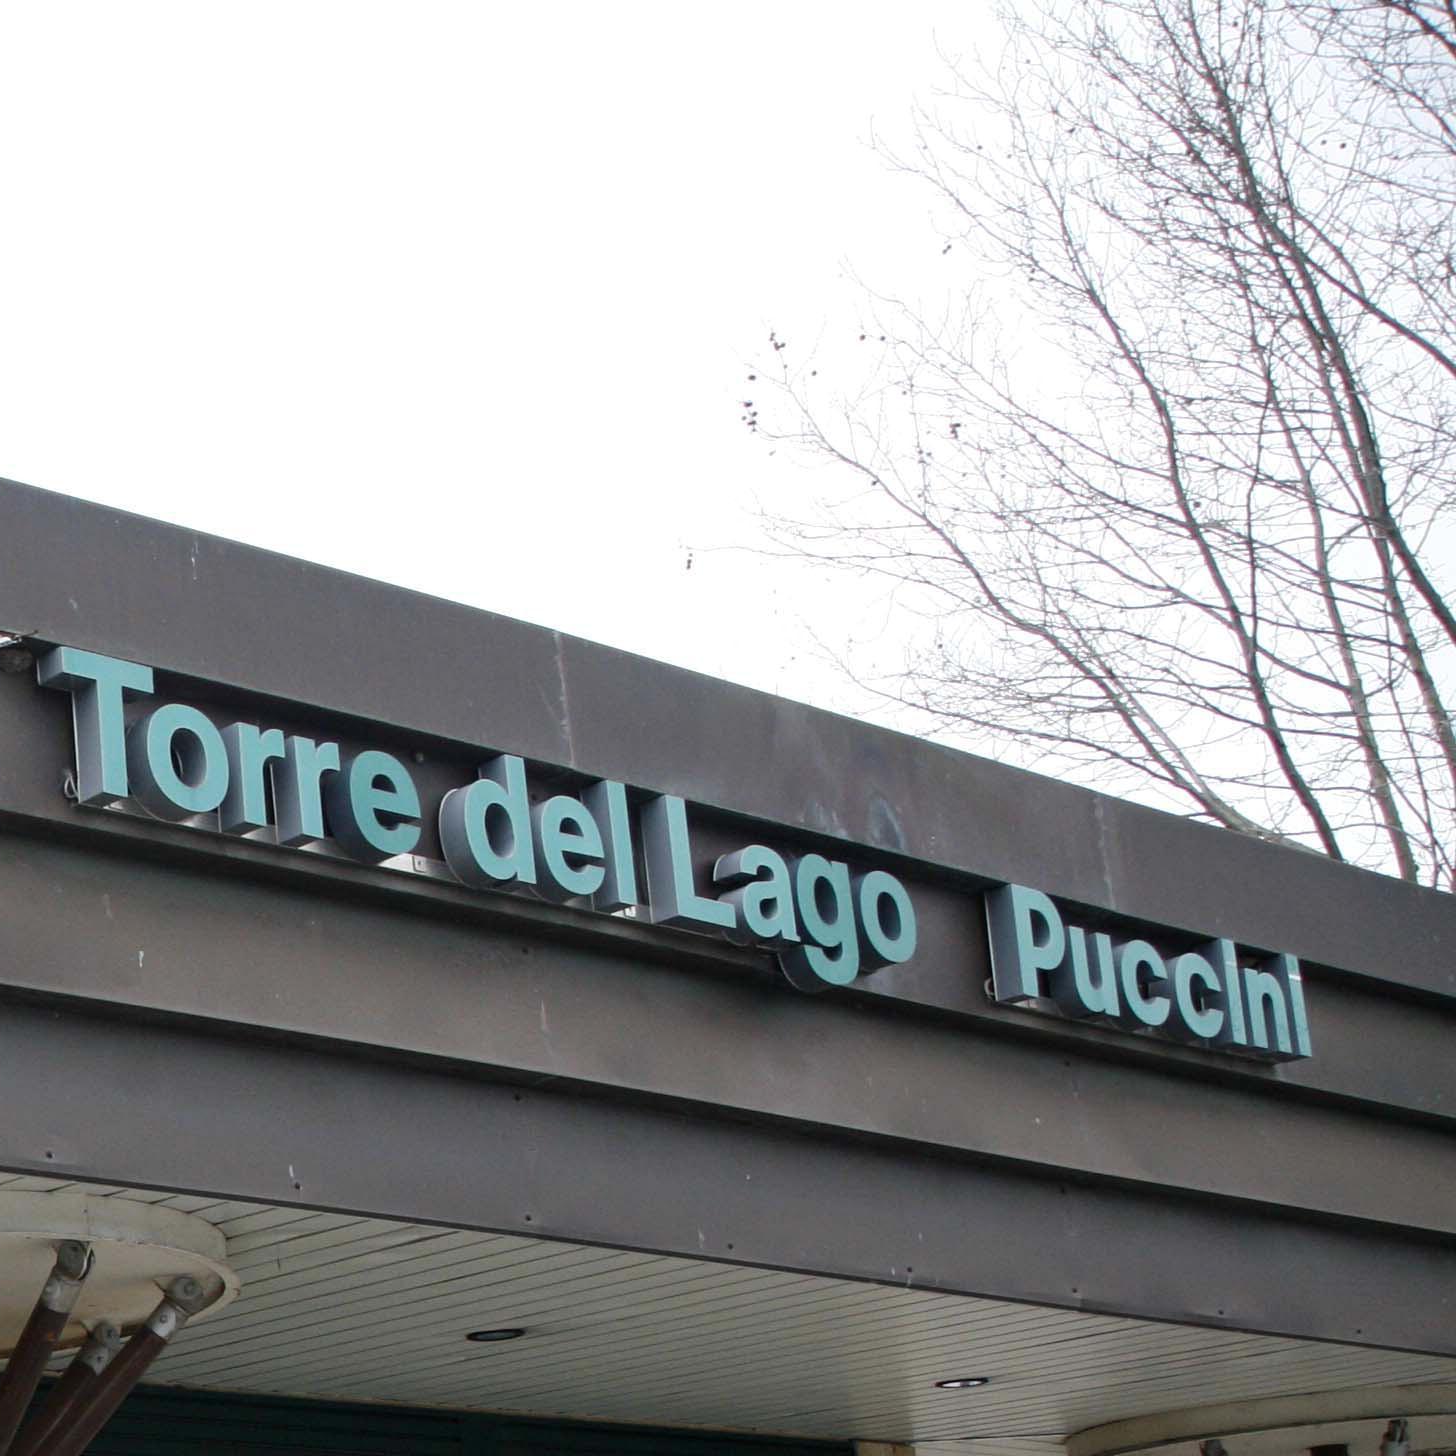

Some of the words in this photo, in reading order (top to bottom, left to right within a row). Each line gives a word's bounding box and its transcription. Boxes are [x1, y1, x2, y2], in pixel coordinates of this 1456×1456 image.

[45, 646, 422, 855] Torre
[460, 756, 639, 905] del
[661, 797, 919, 987] Lago
[1004, 885, 1312, 1058] Puccini
